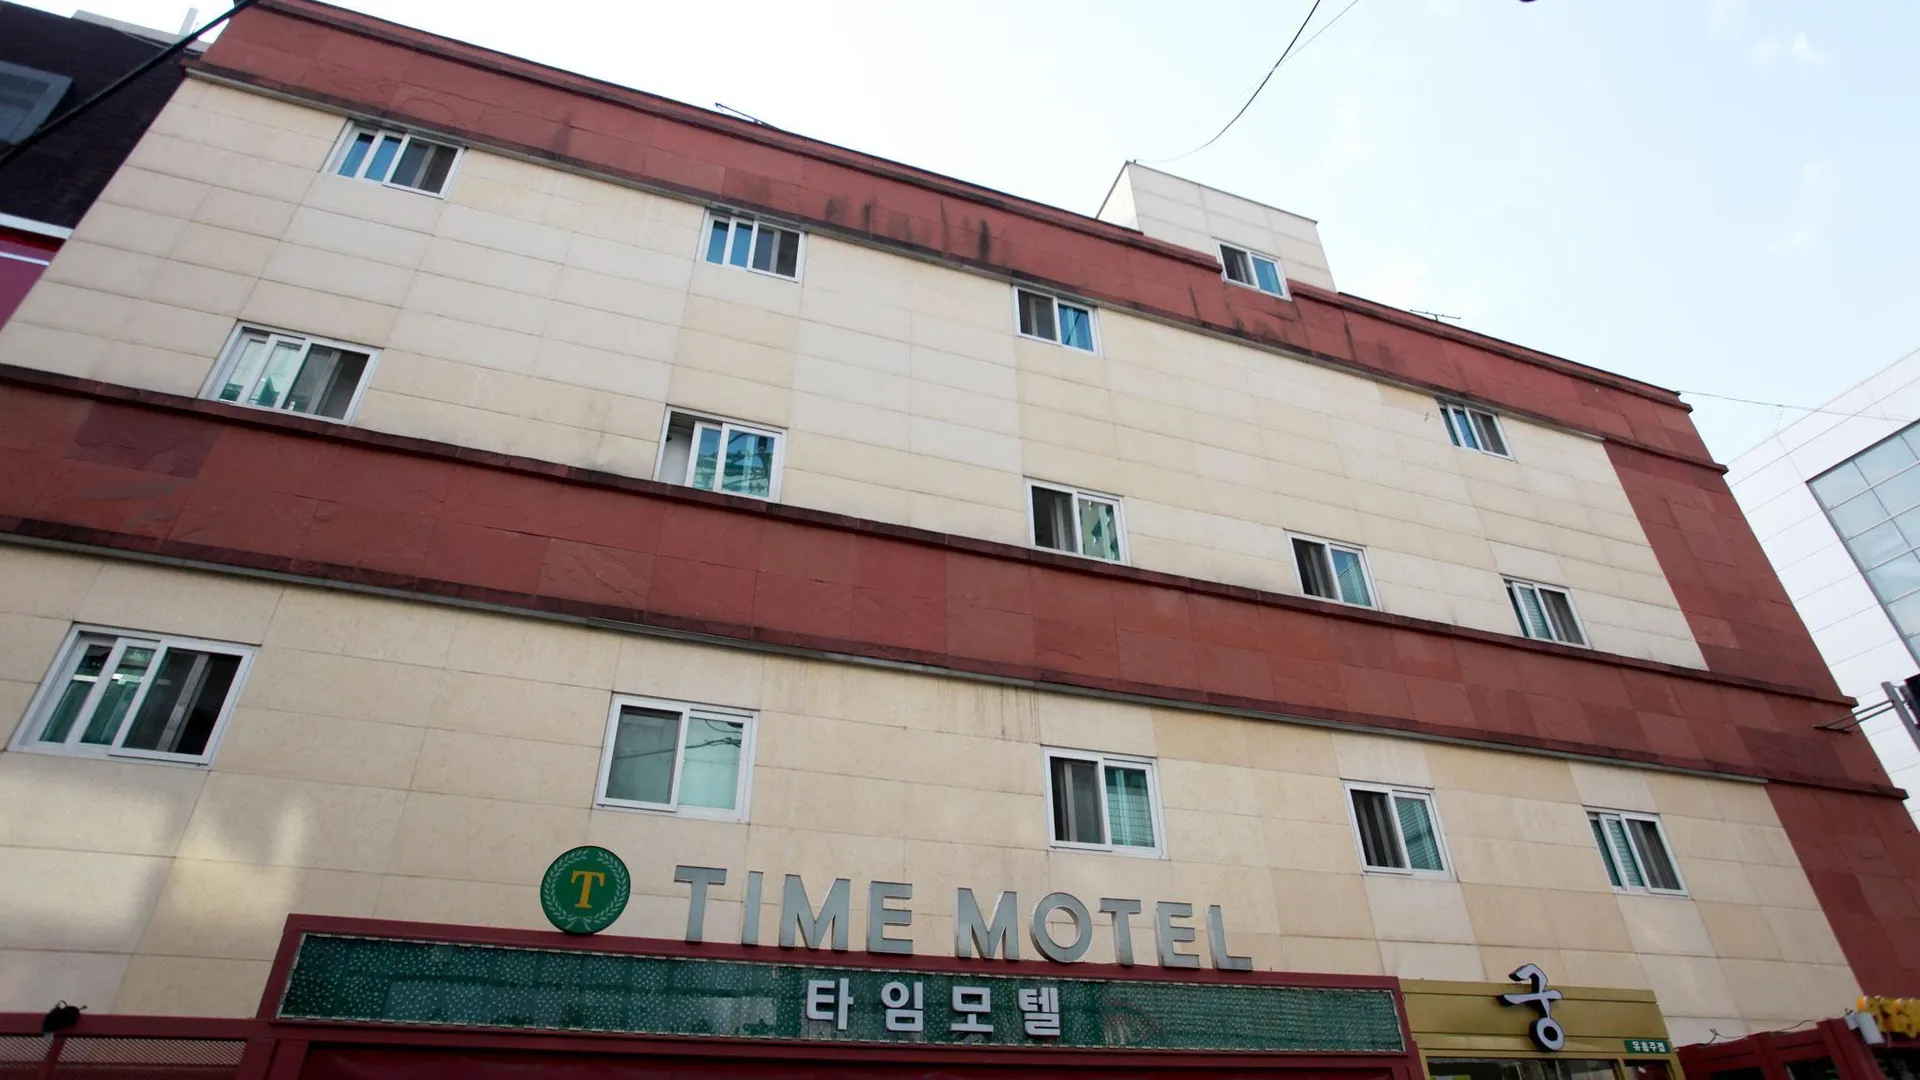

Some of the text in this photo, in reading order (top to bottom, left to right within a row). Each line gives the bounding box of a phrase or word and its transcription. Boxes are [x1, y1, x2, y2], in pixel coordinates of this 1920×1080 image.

[570, 870, 605, 909] T
[675, 865, 1253, 971] TIME MOTEL
[806, 978, 1061, 1036] 타임모텔
[1498, 963, 1565, 1051] 궁
